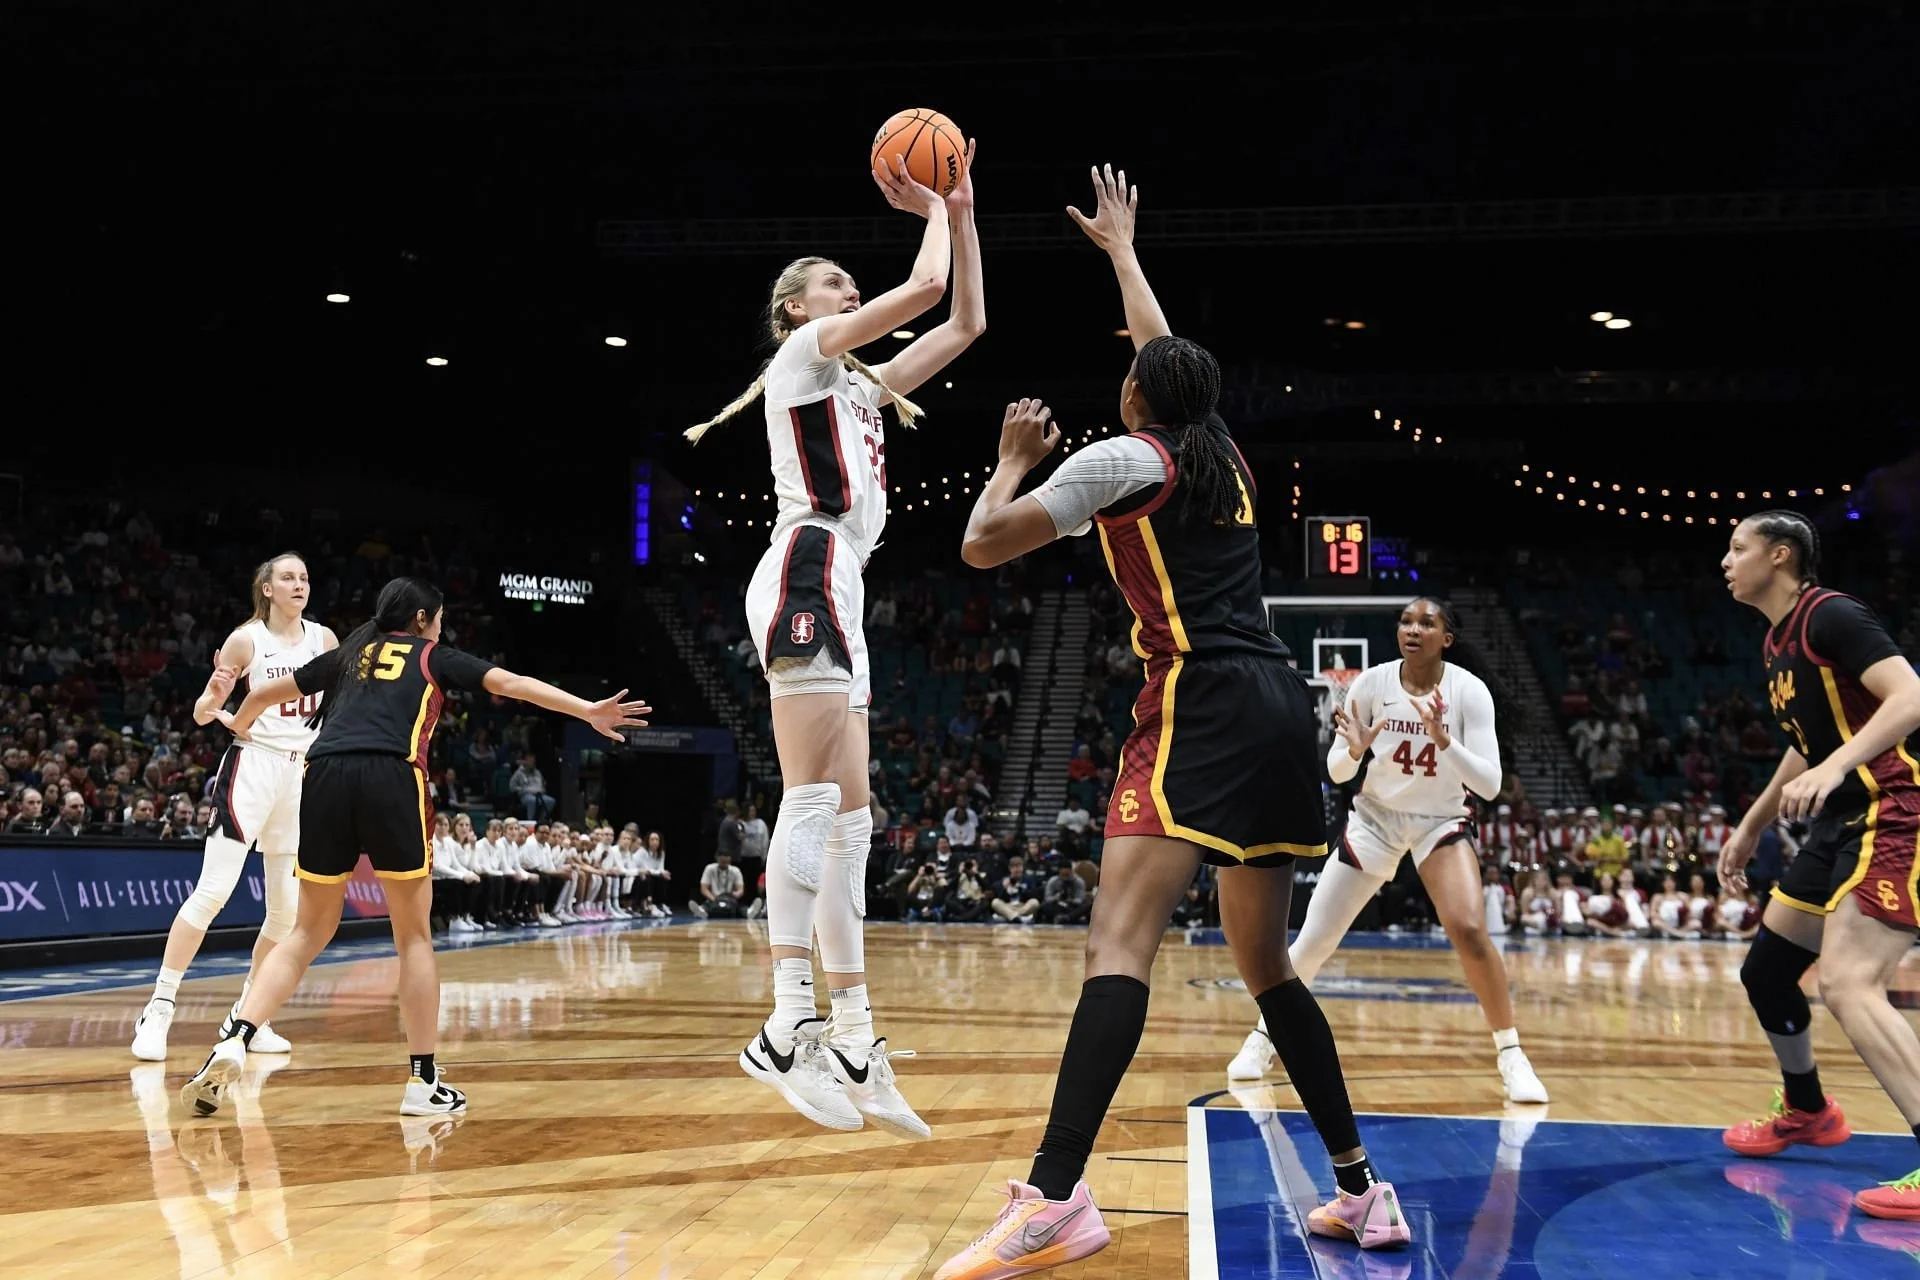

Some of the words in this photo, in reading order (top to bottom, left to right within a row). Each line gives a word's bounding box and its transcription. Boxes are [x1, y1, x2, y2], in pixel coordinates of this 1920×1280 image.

[1322, 522, 1364, 543] 8:16
[1328, 540, 1360, 575] 13
[499, 572, 538, 590] MGM
[540, 576, 593, 594] GRAND
[1392, 739, 1438, 777] 44
